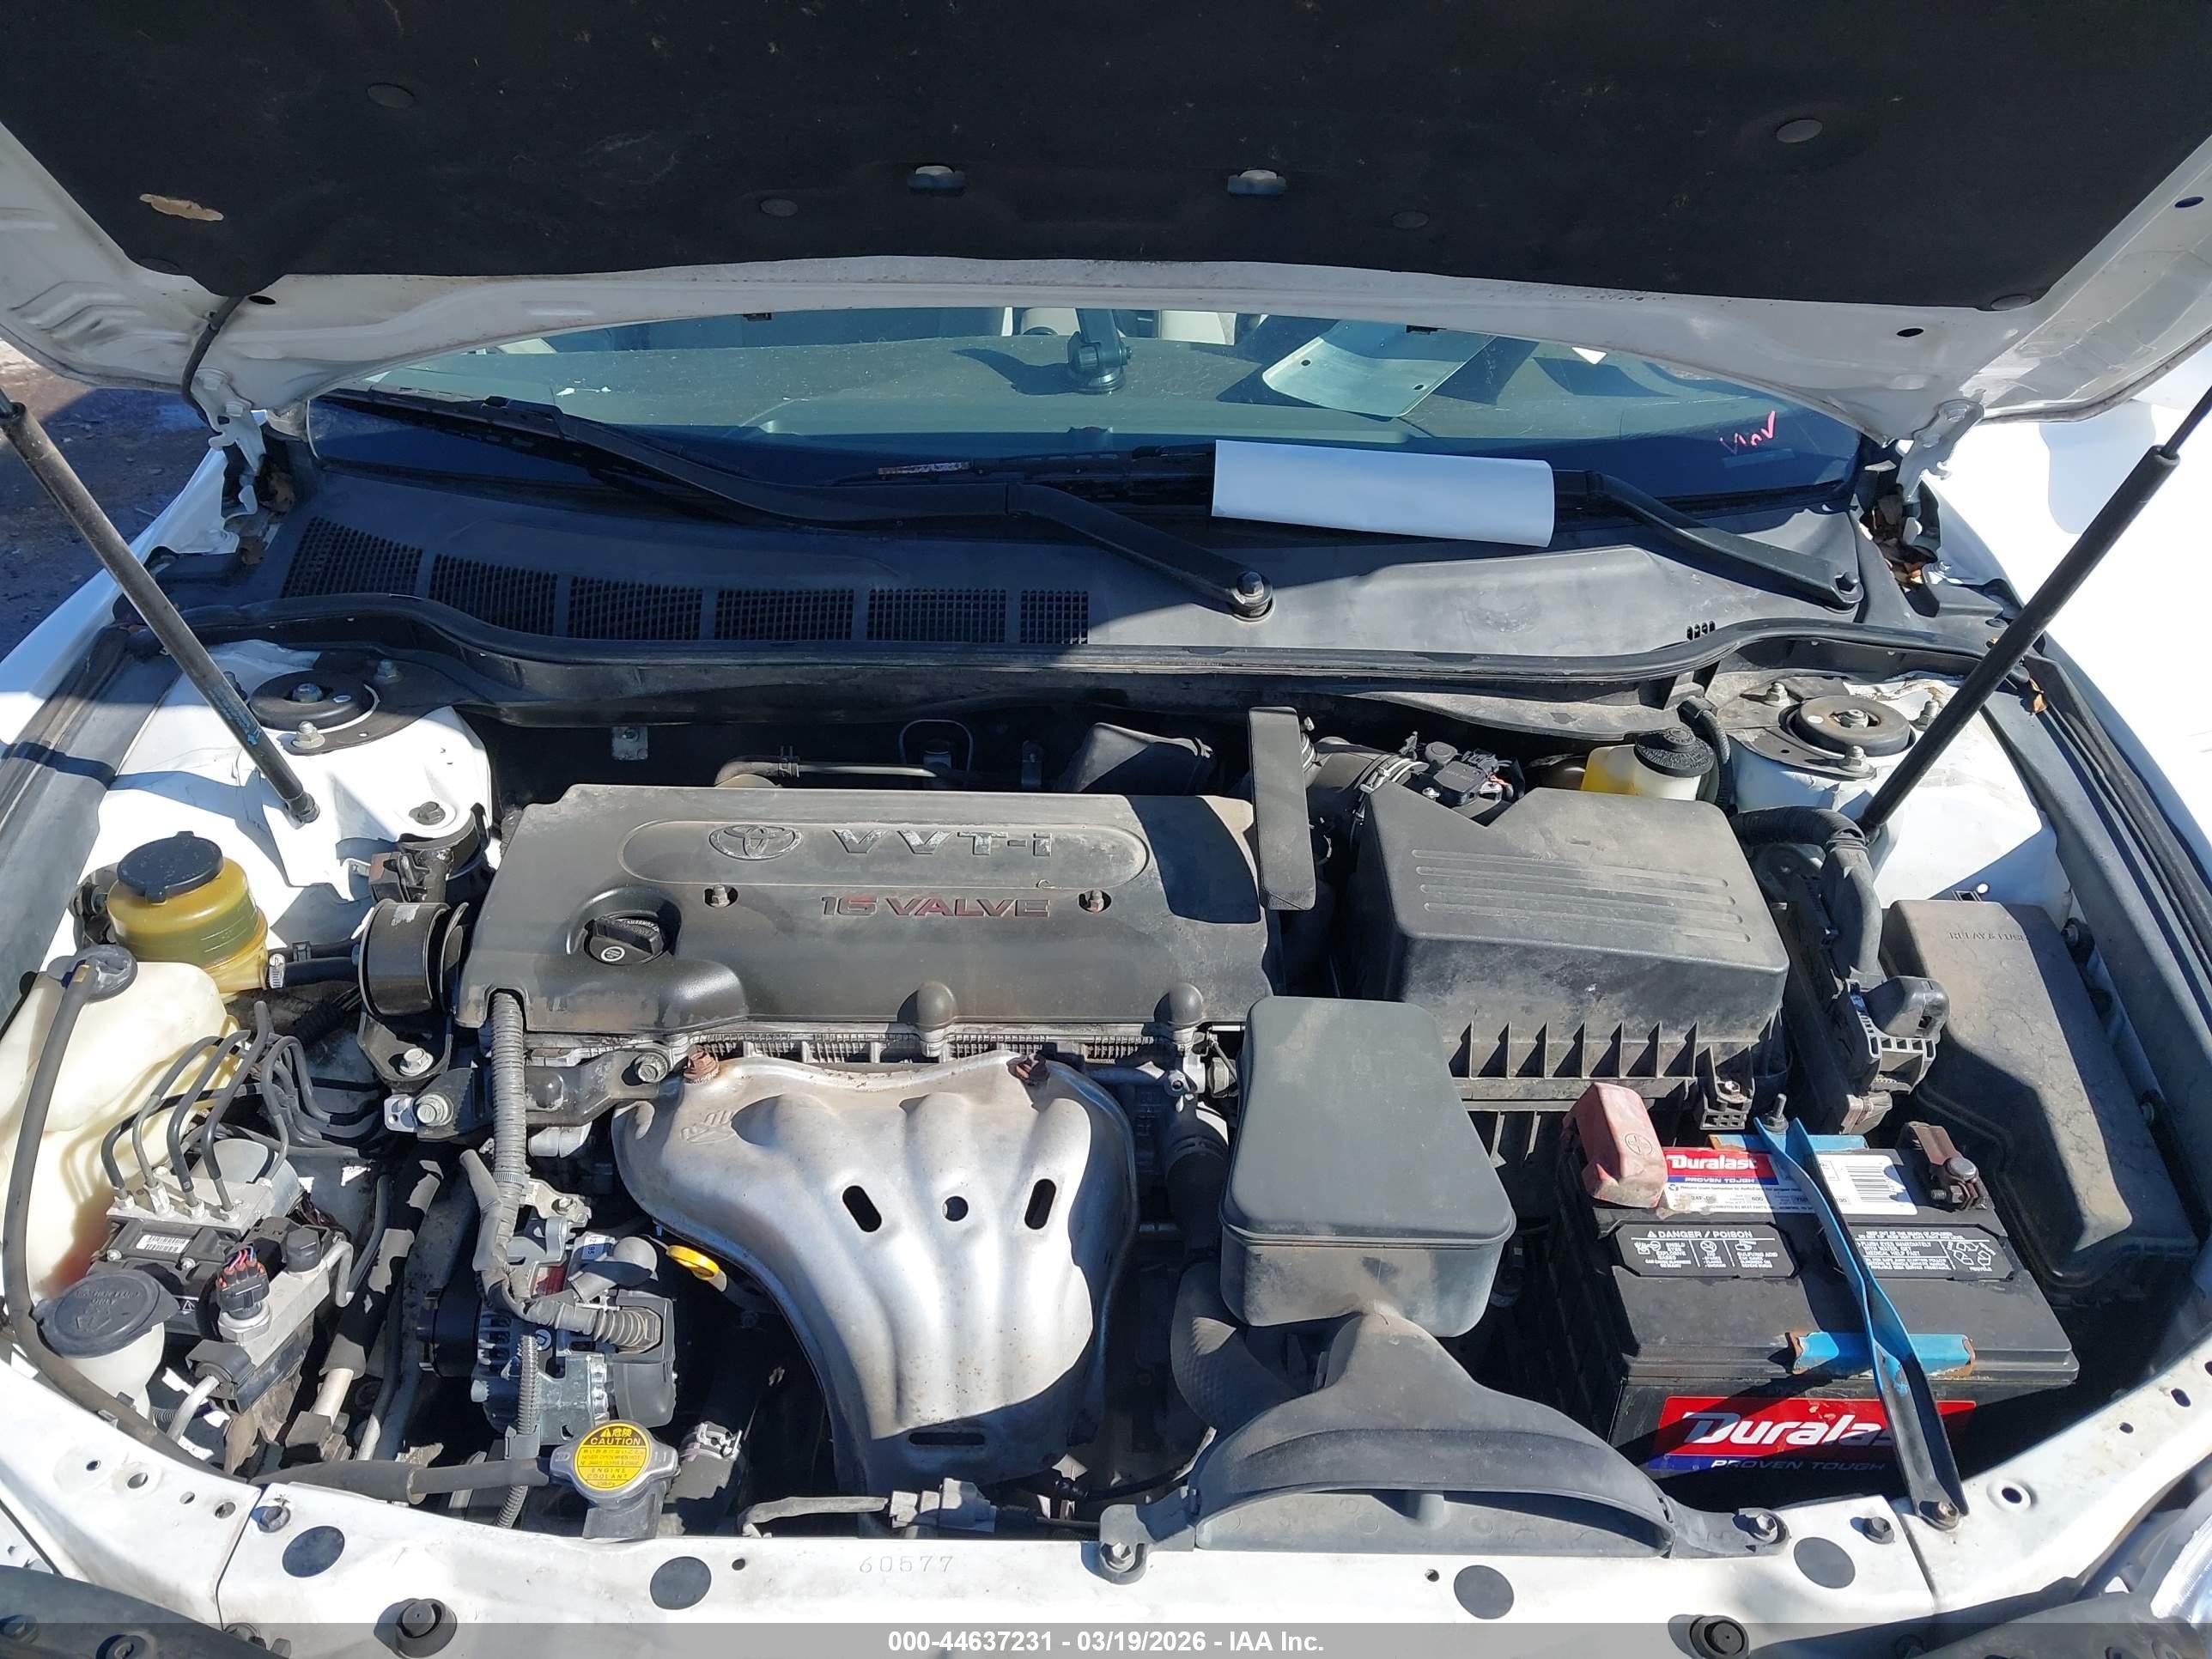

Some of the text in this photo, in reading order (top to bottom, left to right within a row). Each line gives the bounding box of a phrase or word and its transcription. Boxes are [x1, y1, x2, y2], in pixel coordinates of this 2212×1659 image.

[822, 896, 1051, 918] 16 VALVE
[1949, 932, 1985, 941] RELAY
[1666, 1154, 1759, 1170] Duralast
[1712, 1231, 1753, 1239] POISON
[1683, 1412, 1896, 1447] Duralas
[1711, 1459, 1886, 1472] PROVEN TOUGH
[859, 1555, 954, 1573] 60577
